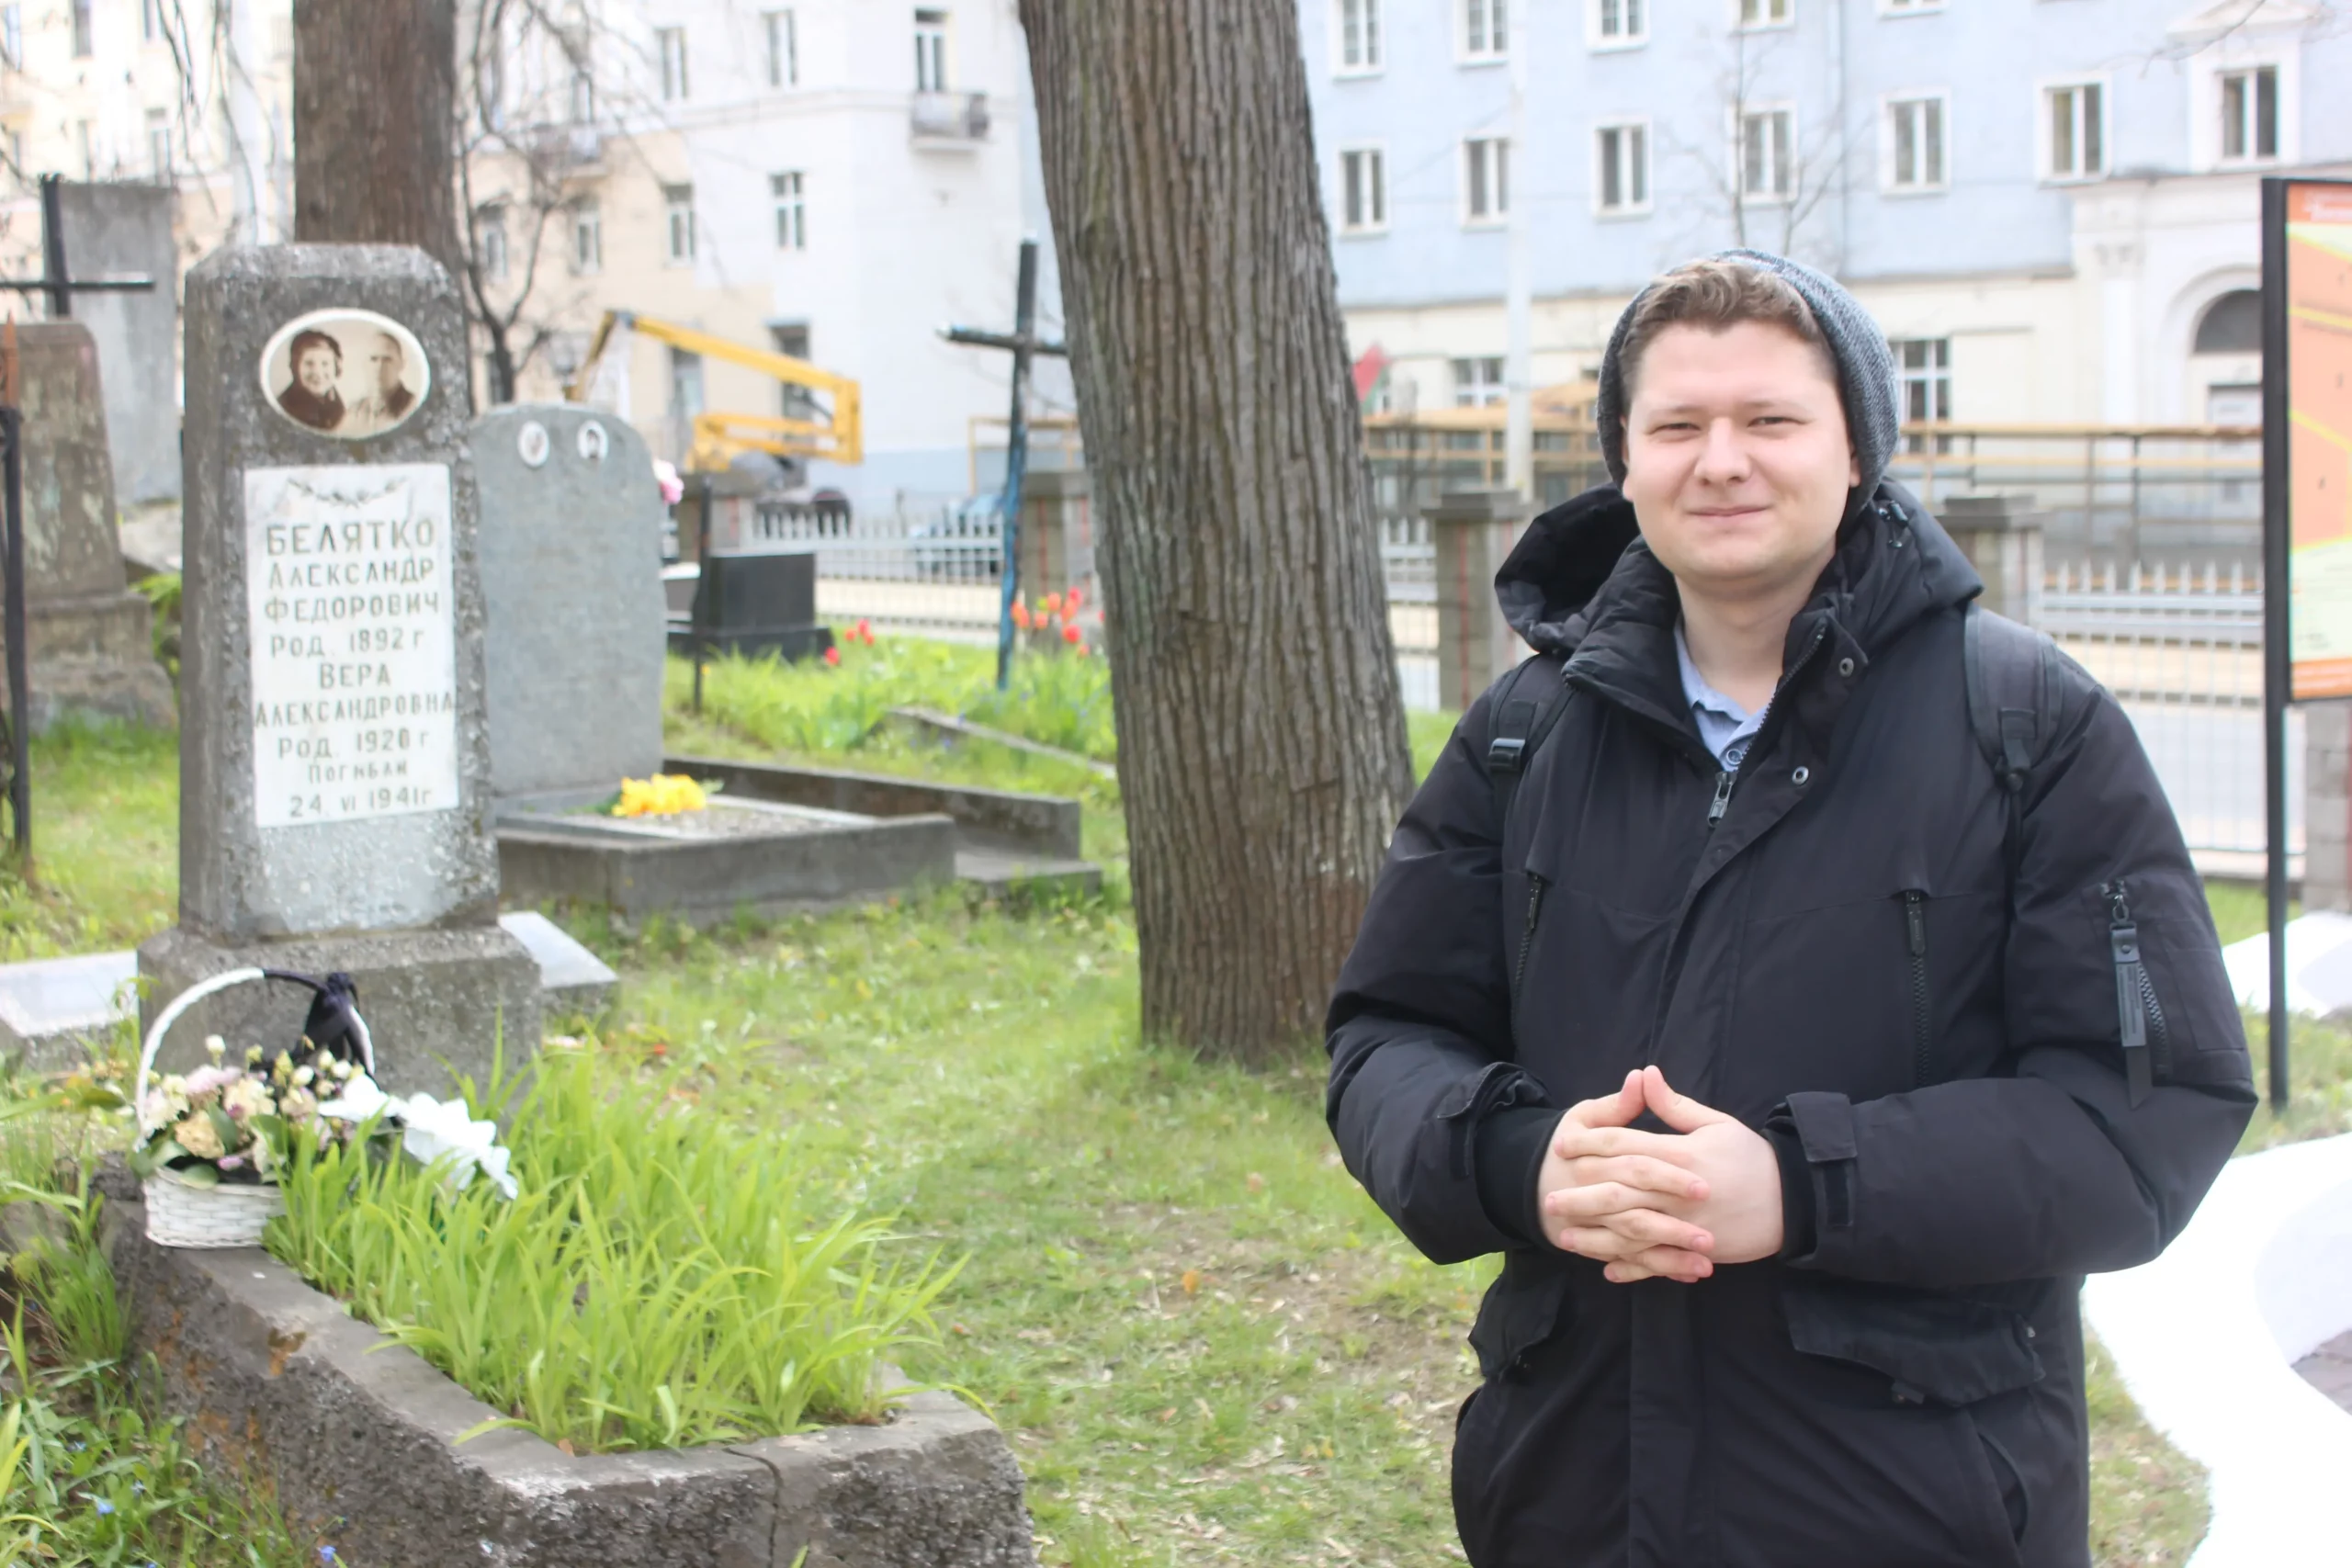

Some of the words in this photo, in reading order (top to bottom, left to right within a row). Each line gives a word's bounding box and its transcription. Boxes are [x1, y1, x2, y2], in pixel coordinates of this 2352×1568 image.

[266, 518, 434, 557] БЕЛЯТКО
[269, 558, 435, 590] АЛЕКСАНДР
[264, 592, 439, 625] ФЕДОРОВИЧ
[349, 626, 404, 653] 1892
[319, 661, 391, 690] ВЕРА
[254, 691, 455, 728] АЛЕКСАНДРОВНА
[308, 760, 408, 784] ПОГИБЛИ
